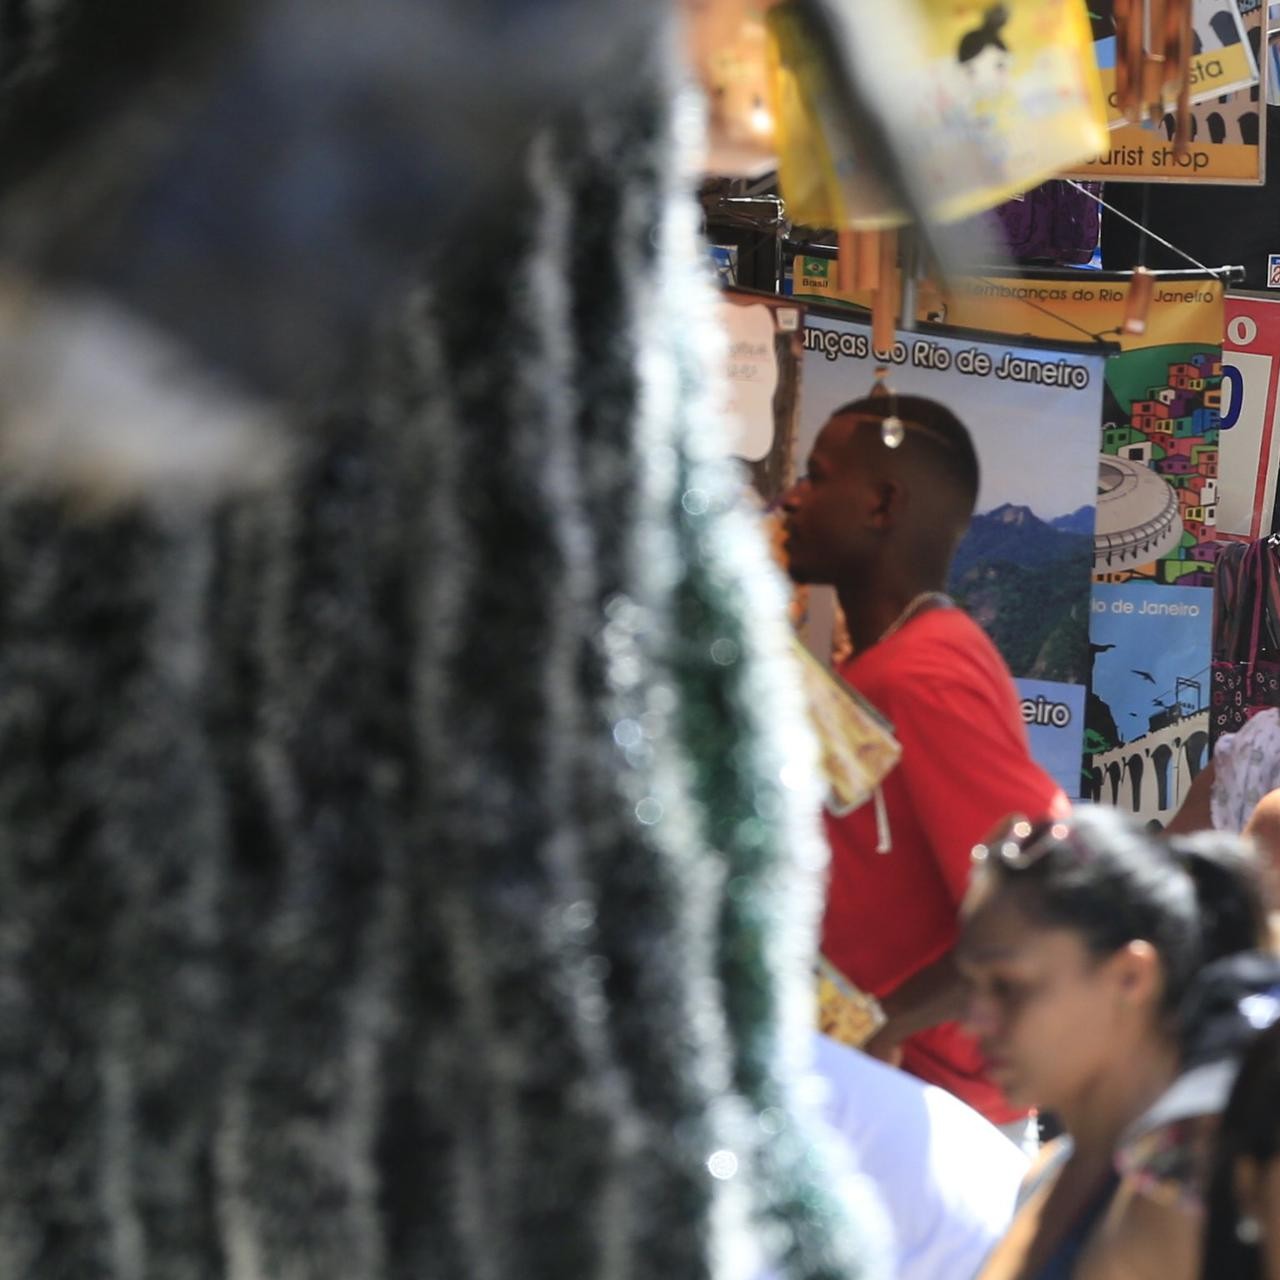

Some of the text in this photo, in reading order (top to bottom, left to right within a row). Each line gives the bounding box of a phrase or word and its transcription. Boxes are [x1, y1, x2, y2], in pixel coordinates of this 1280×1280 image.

[1151, 147, 1210, 171] shop
[802, 277, 829, 290] Brasil
[966, 283, 1214, 304] embranças do Rio Janeiro
[912, 341, 950, 370] Rio
[956, 350, 991, 376] de
[995, 354, 1090, 388] Janeiro
[1111, 599, 1135, 615] de
[1138, 600, 1201, 617] Janeiro
